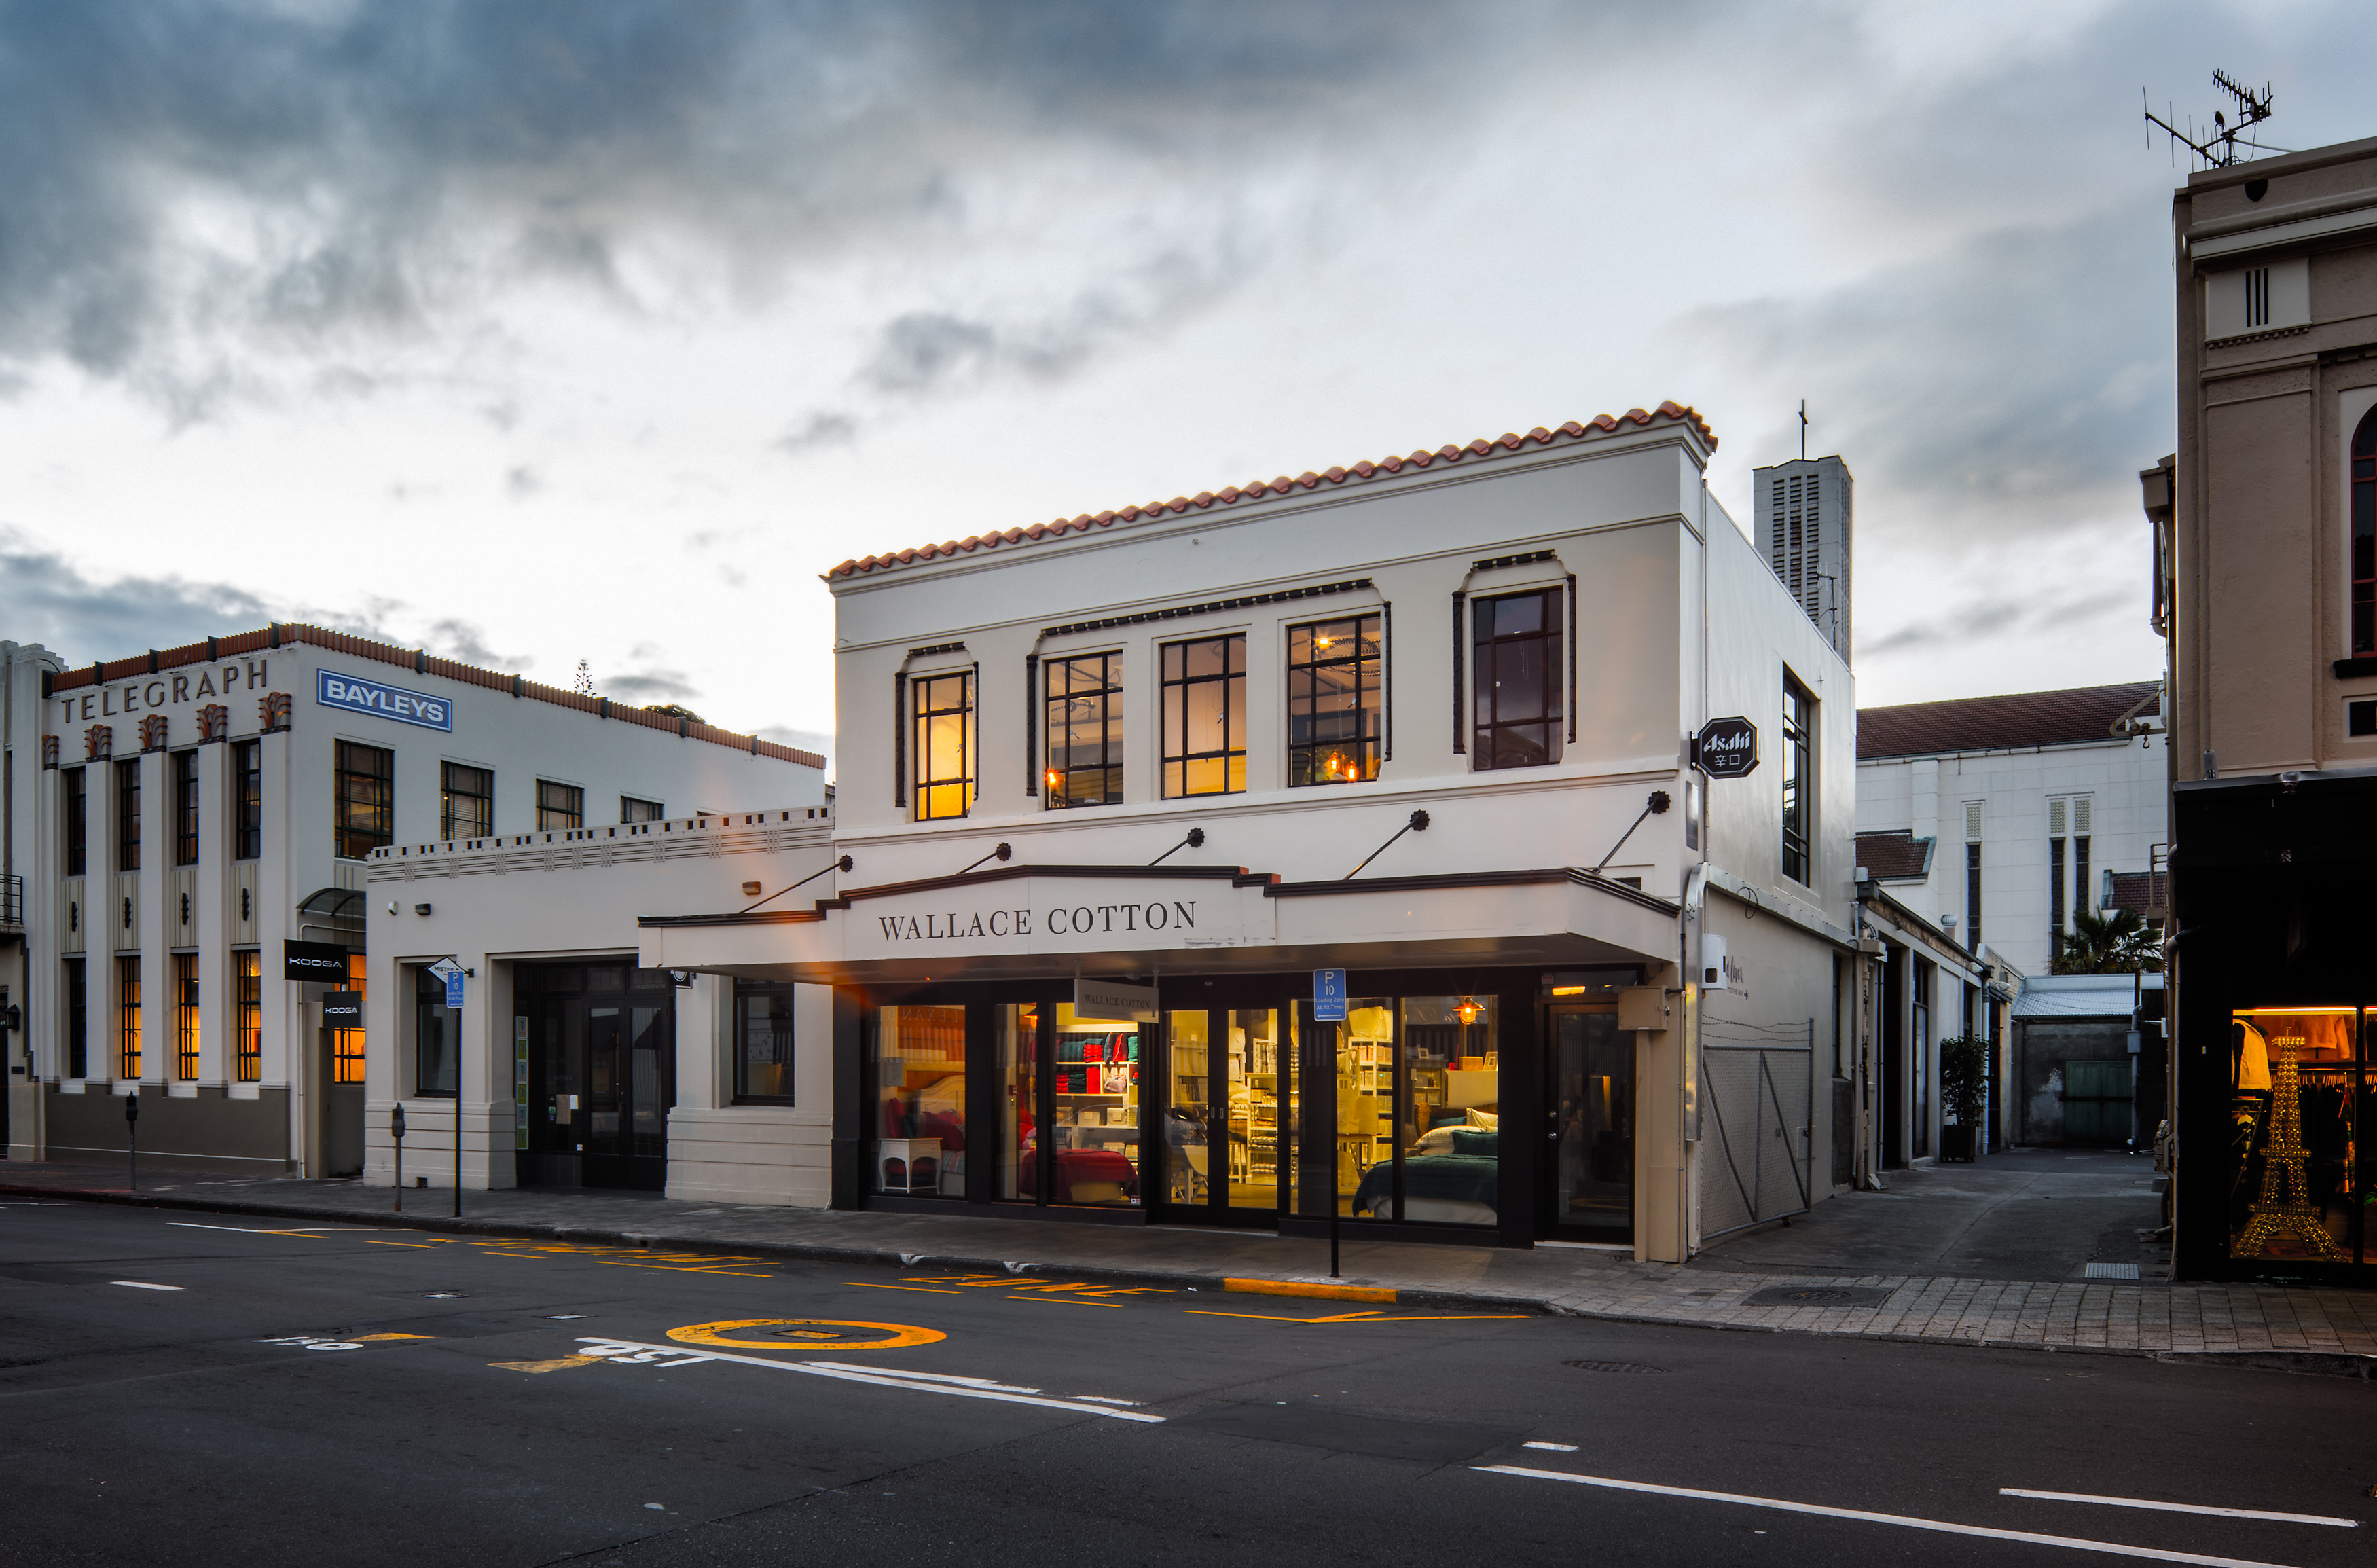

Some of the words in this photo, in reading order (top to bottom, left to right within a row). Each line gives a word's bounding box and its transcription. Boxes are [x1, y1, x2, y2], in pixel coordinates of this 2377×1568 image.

[61, 659, 267, 723] TELEGRAPH
[327, 680, 444, 723] BAYLEYS
[1703, 731, 1750, 752] Asahi
[1715, 754, 1740, 767] 辛口
[879, 910, 1032, 941] WALLACE
[1047, 901, 1197, 935] COTTON
[289, 958, 342, 968] KOOGA
[453, 973, 458, 982] P
[1325, 971, 1335, 984] P
[1326, 985, 1335, 996] 10
[1085, 994, 1119, 1006] WALLACE
[1121, 998, 1150, 1009] COTTON
[898, 1273, 1177, 1298] ZONE
